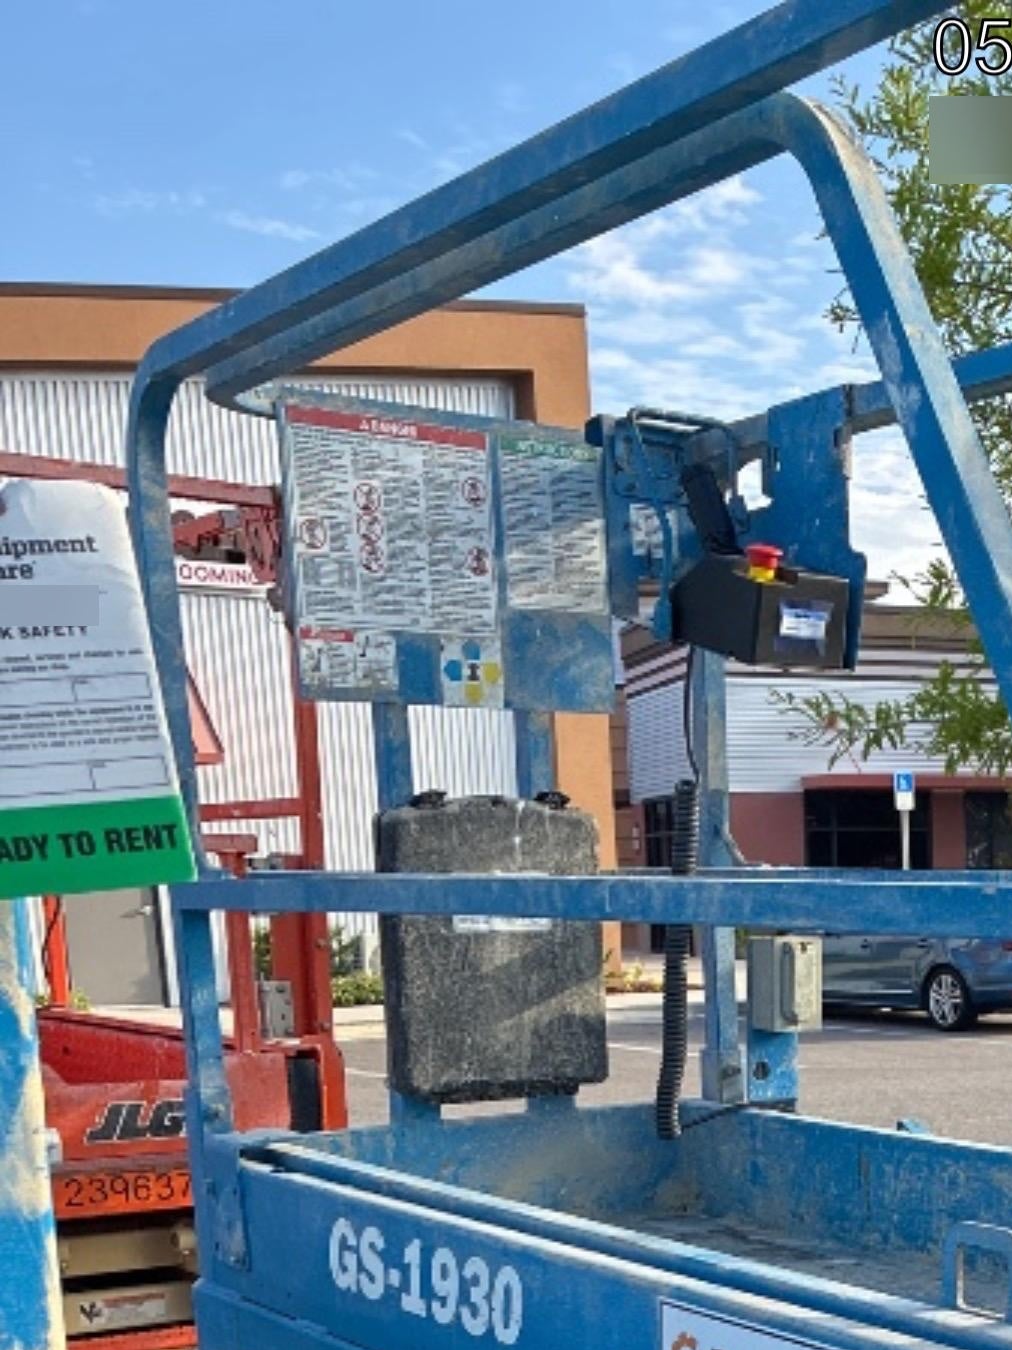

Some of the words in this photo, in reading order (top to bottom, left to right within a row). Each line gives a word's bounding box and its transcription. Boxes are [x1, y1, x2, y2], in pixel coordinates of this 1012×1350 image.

[58, 830, 97, 859] TO
[104, 823, 178, 854] RENT
[85, 1099, 187, 1143] JLG
[65, 1173, 191, 1208] 239637
[329, 1217, 523, 1345] GS-1930
